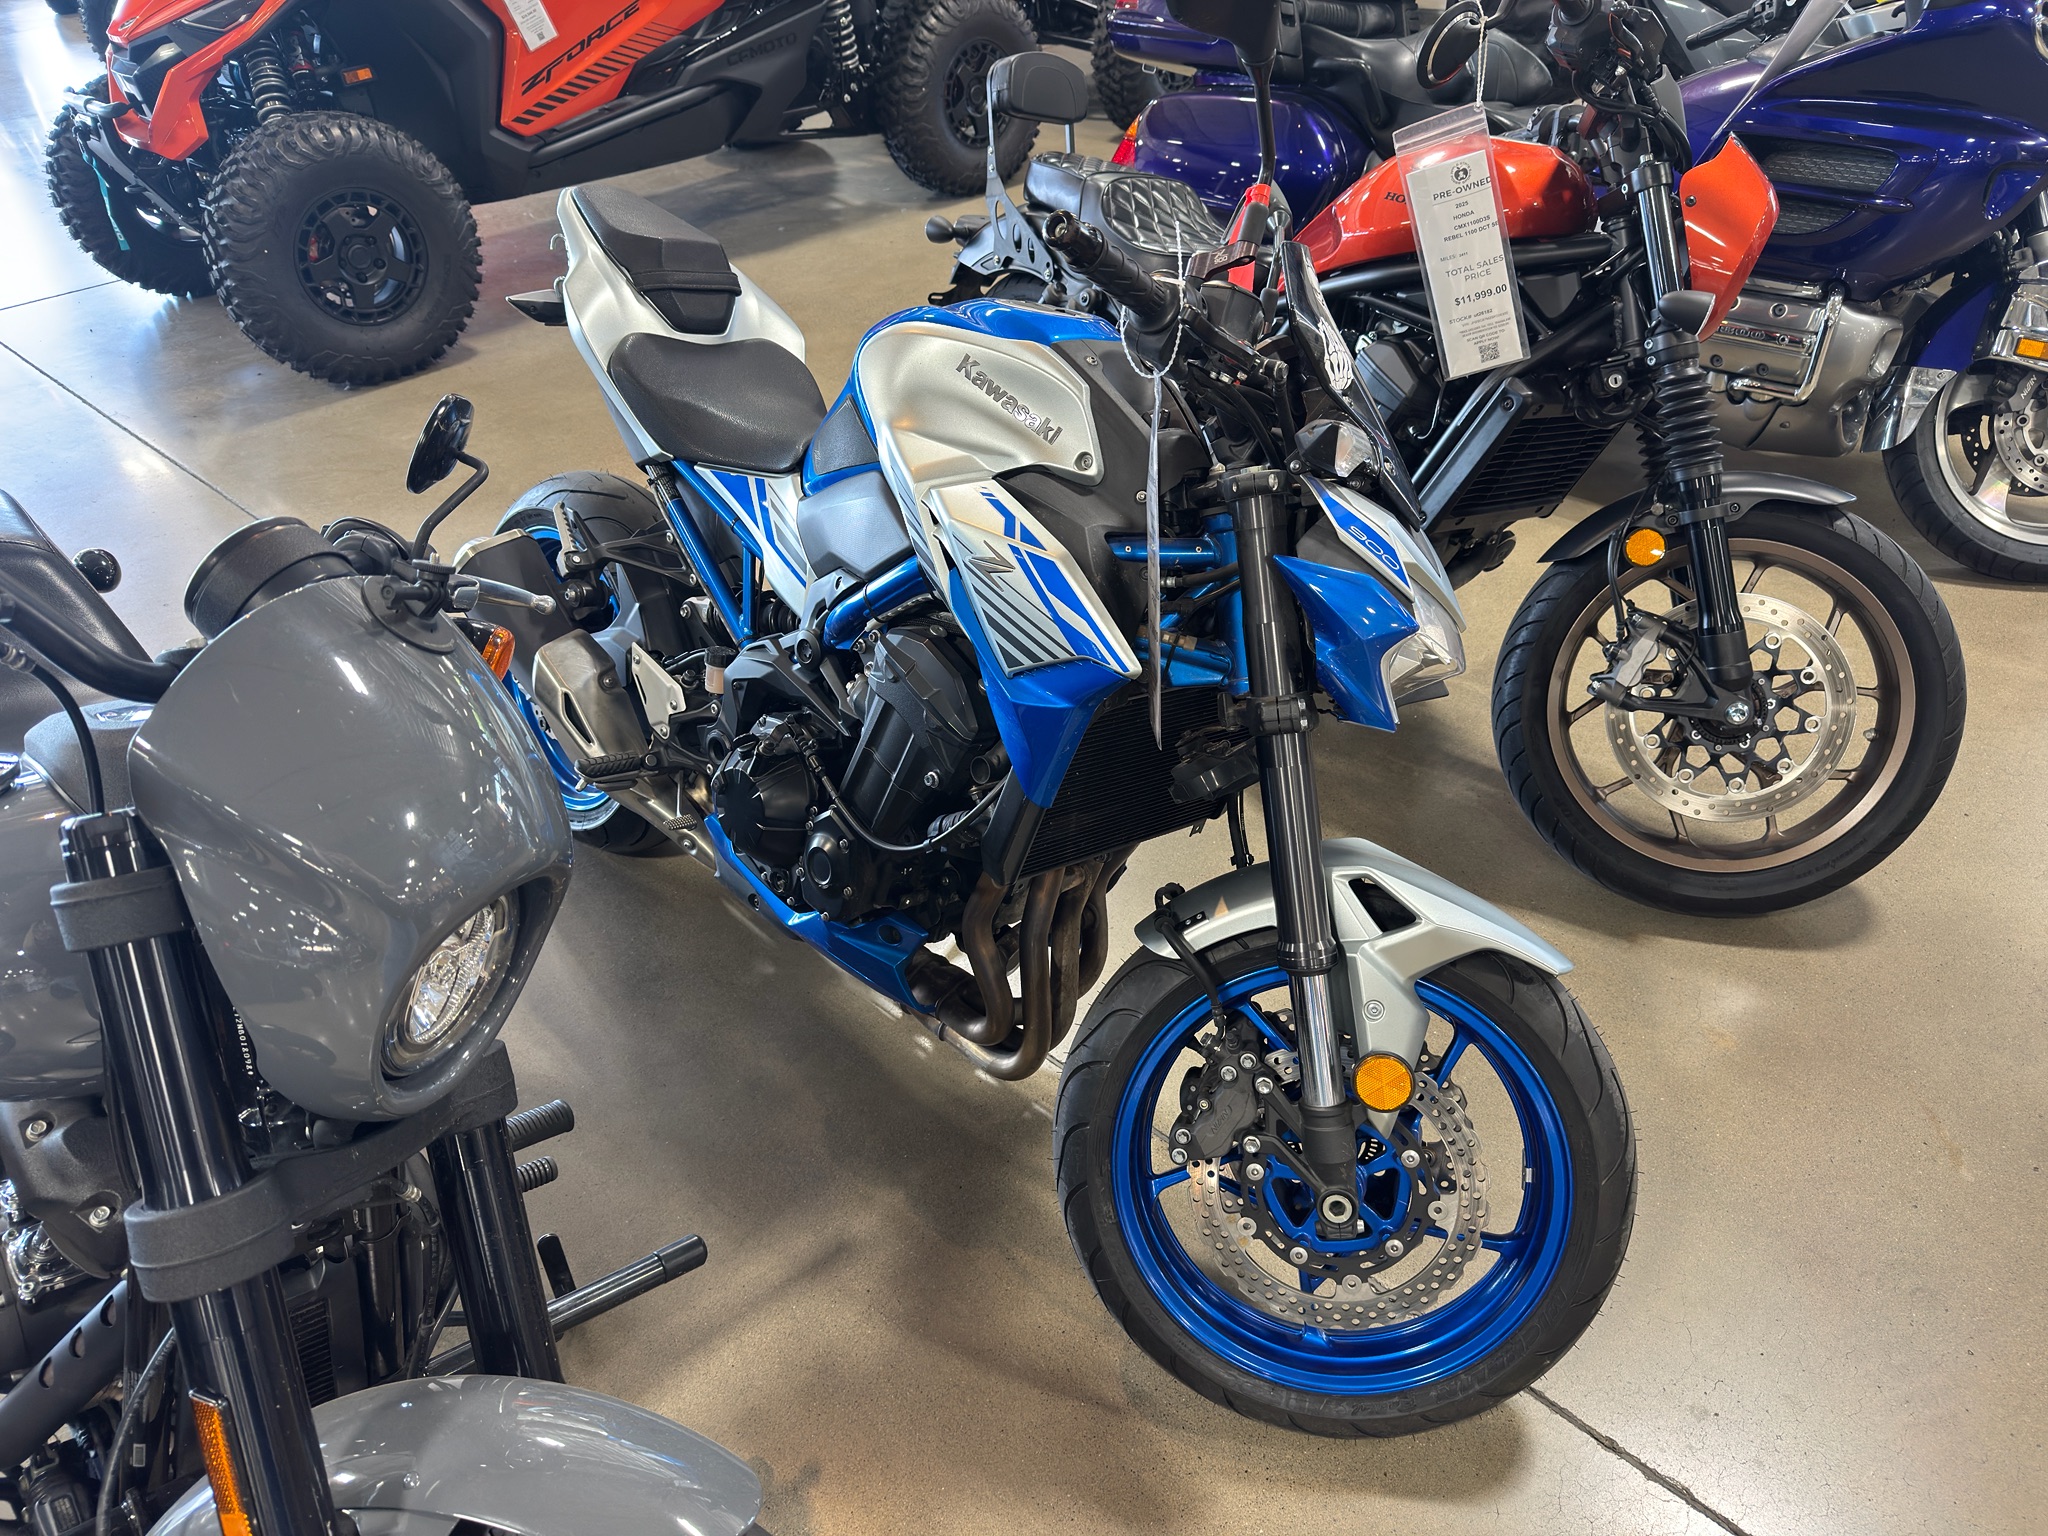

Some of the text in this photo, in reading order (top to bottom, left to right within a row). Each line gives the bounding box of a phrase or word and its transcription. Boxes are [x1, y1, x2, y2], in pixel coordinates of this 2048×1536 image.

[521, 0, 640, 96] ZFORCE
[727, 32, 797, 66] CFMOTO
[1433, 176, 1491, 200] PRE-OWNED
[1453, 210, 1475, 220] HONDA
[1455, 200, 1469, 209] 2025
[1443, 233, 1463, 242] REBEL
[1464, 228, 1478, 236] 1100
[1478, 224, 1490, 232] DCT
[1213, 255, 1228, 264] 900
[1445, 254, 1504, 277] TOTAL SALES
[1464, 268, 1492, 282] PRICE
[1454, 284, 1507, 306] $11,999.00
[1449, 314, 1472, 325] STOCK#
[956, 353, 1064, 446] Kawasaki
[1348, 525, 1400, 570] 900
